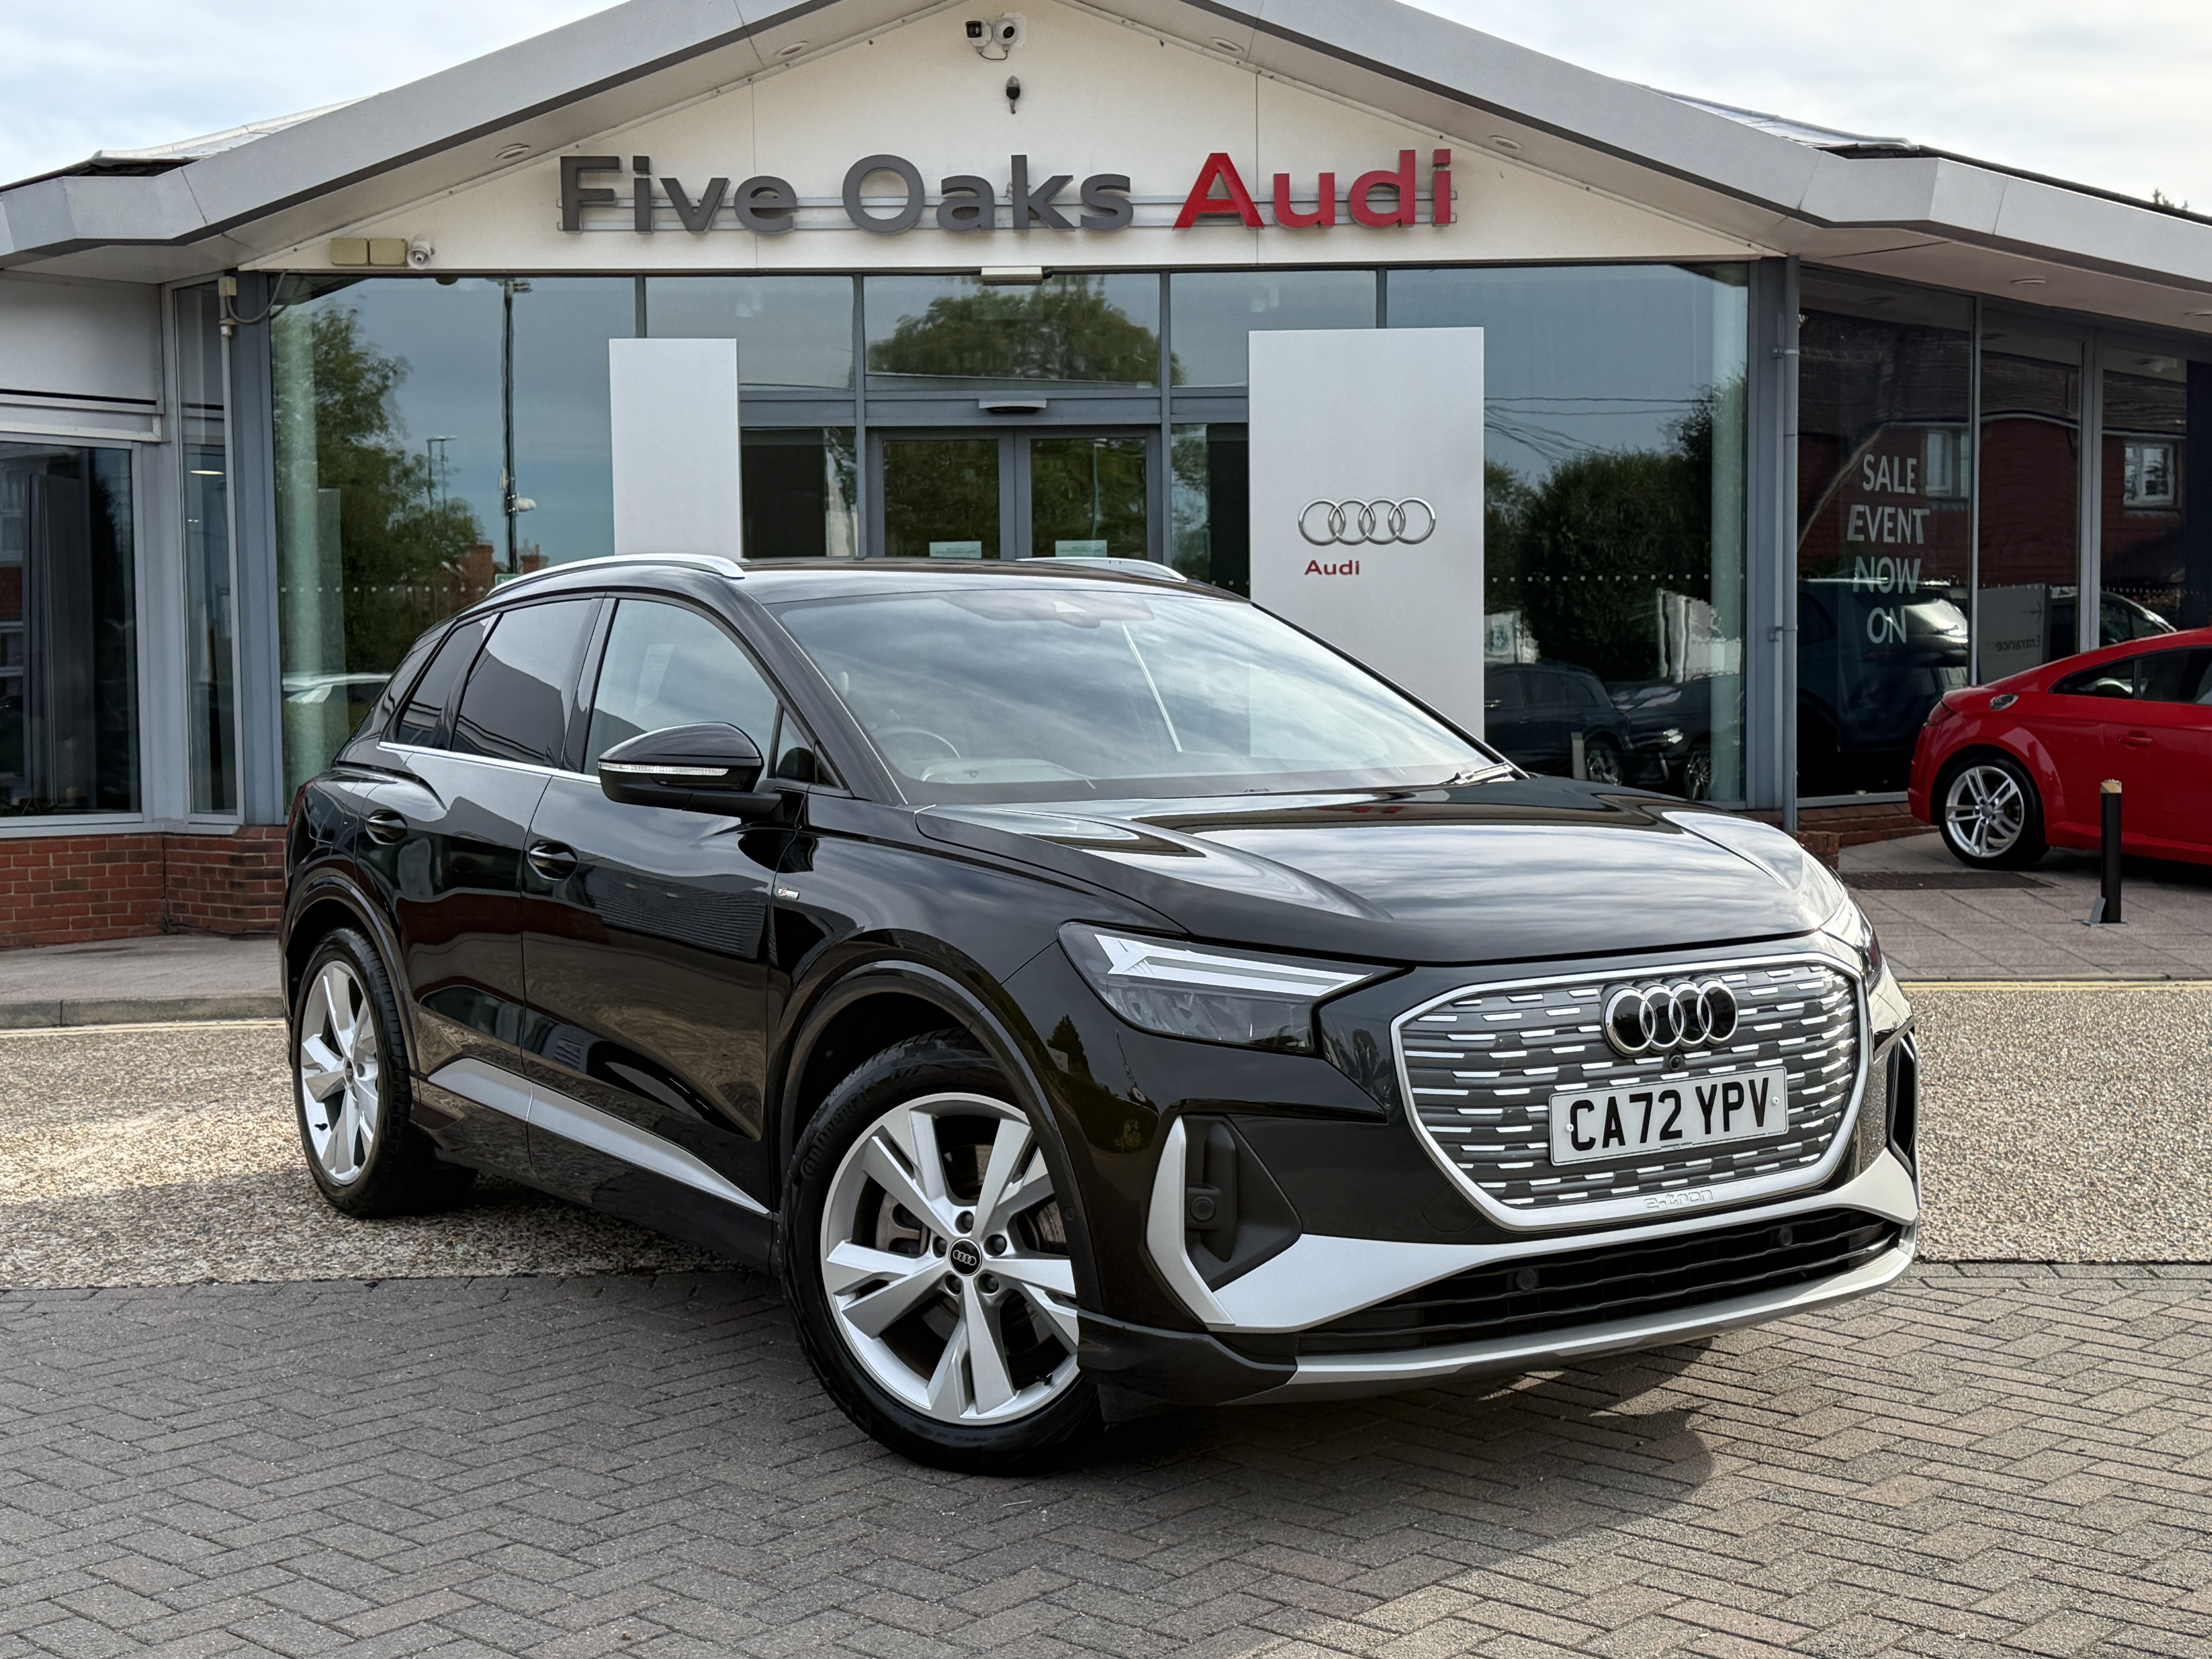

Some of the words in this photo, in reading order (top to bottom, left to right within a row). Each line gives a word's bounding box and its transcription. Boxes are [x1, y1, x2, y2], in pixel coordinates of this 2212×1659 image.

[560, 156, 798, 233] Five
[843, 154, 1133, 232] Oaks
[1173, 149, 1451, 229] Audi
[1863, 454, 1917, 494] SALE
[1847, 505, 1930, 544] EVENT
[1304, 560, 1360, 575] Audi
[1853, 556, 1921, 594] NOW
[1867, 607, 1906, 643] ON
[1570, 1090, 1682, 1151] CA72
[1695, 1077, 1769, 1134] YPV
[1644, 1190, 1713, 1209] e-tron
